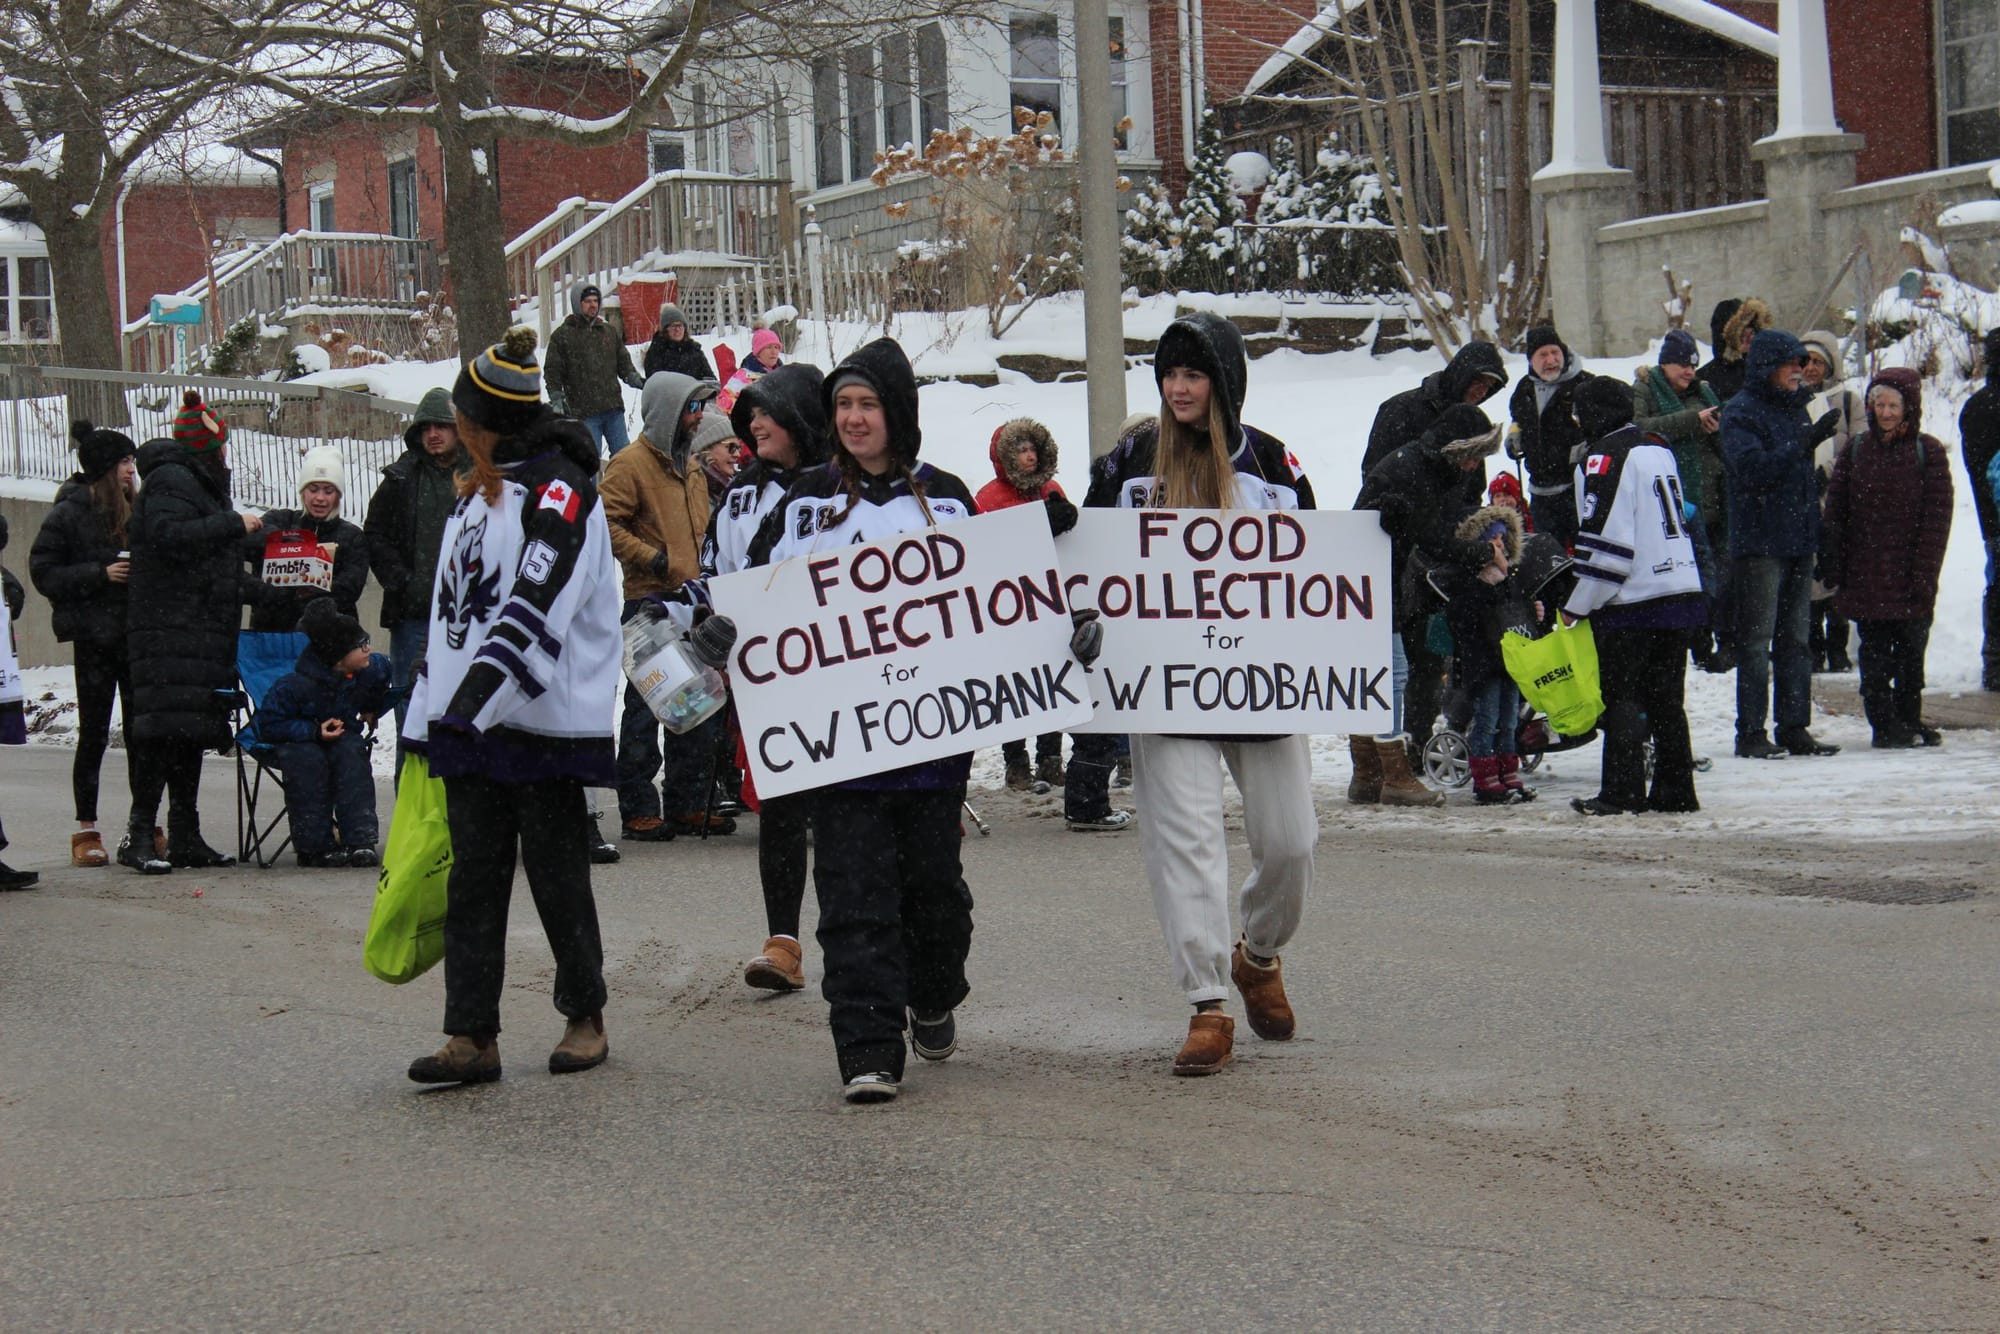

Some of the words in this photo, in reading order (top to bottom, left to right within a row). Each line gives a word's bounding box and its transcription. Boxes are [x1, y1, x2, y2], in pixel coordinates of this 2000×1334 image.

[729, 490, 755, 520] 51
[797, 505, 837, 540] 28
[1139, 512, 1306, 562] FOOD
[266, 559, 311, 575] timbits
[808, 534, 966, 607] FOOD
[737, 568, 1067, 684] COLLECTION
[1202, 624, 1244, 649] for
[881, 663, 920, 685] for
[1163, 663, 1392, 712] FOODBANK
[758, 710, 840, 773] CW
[854, 659, 1080, 753] FOODBANK
